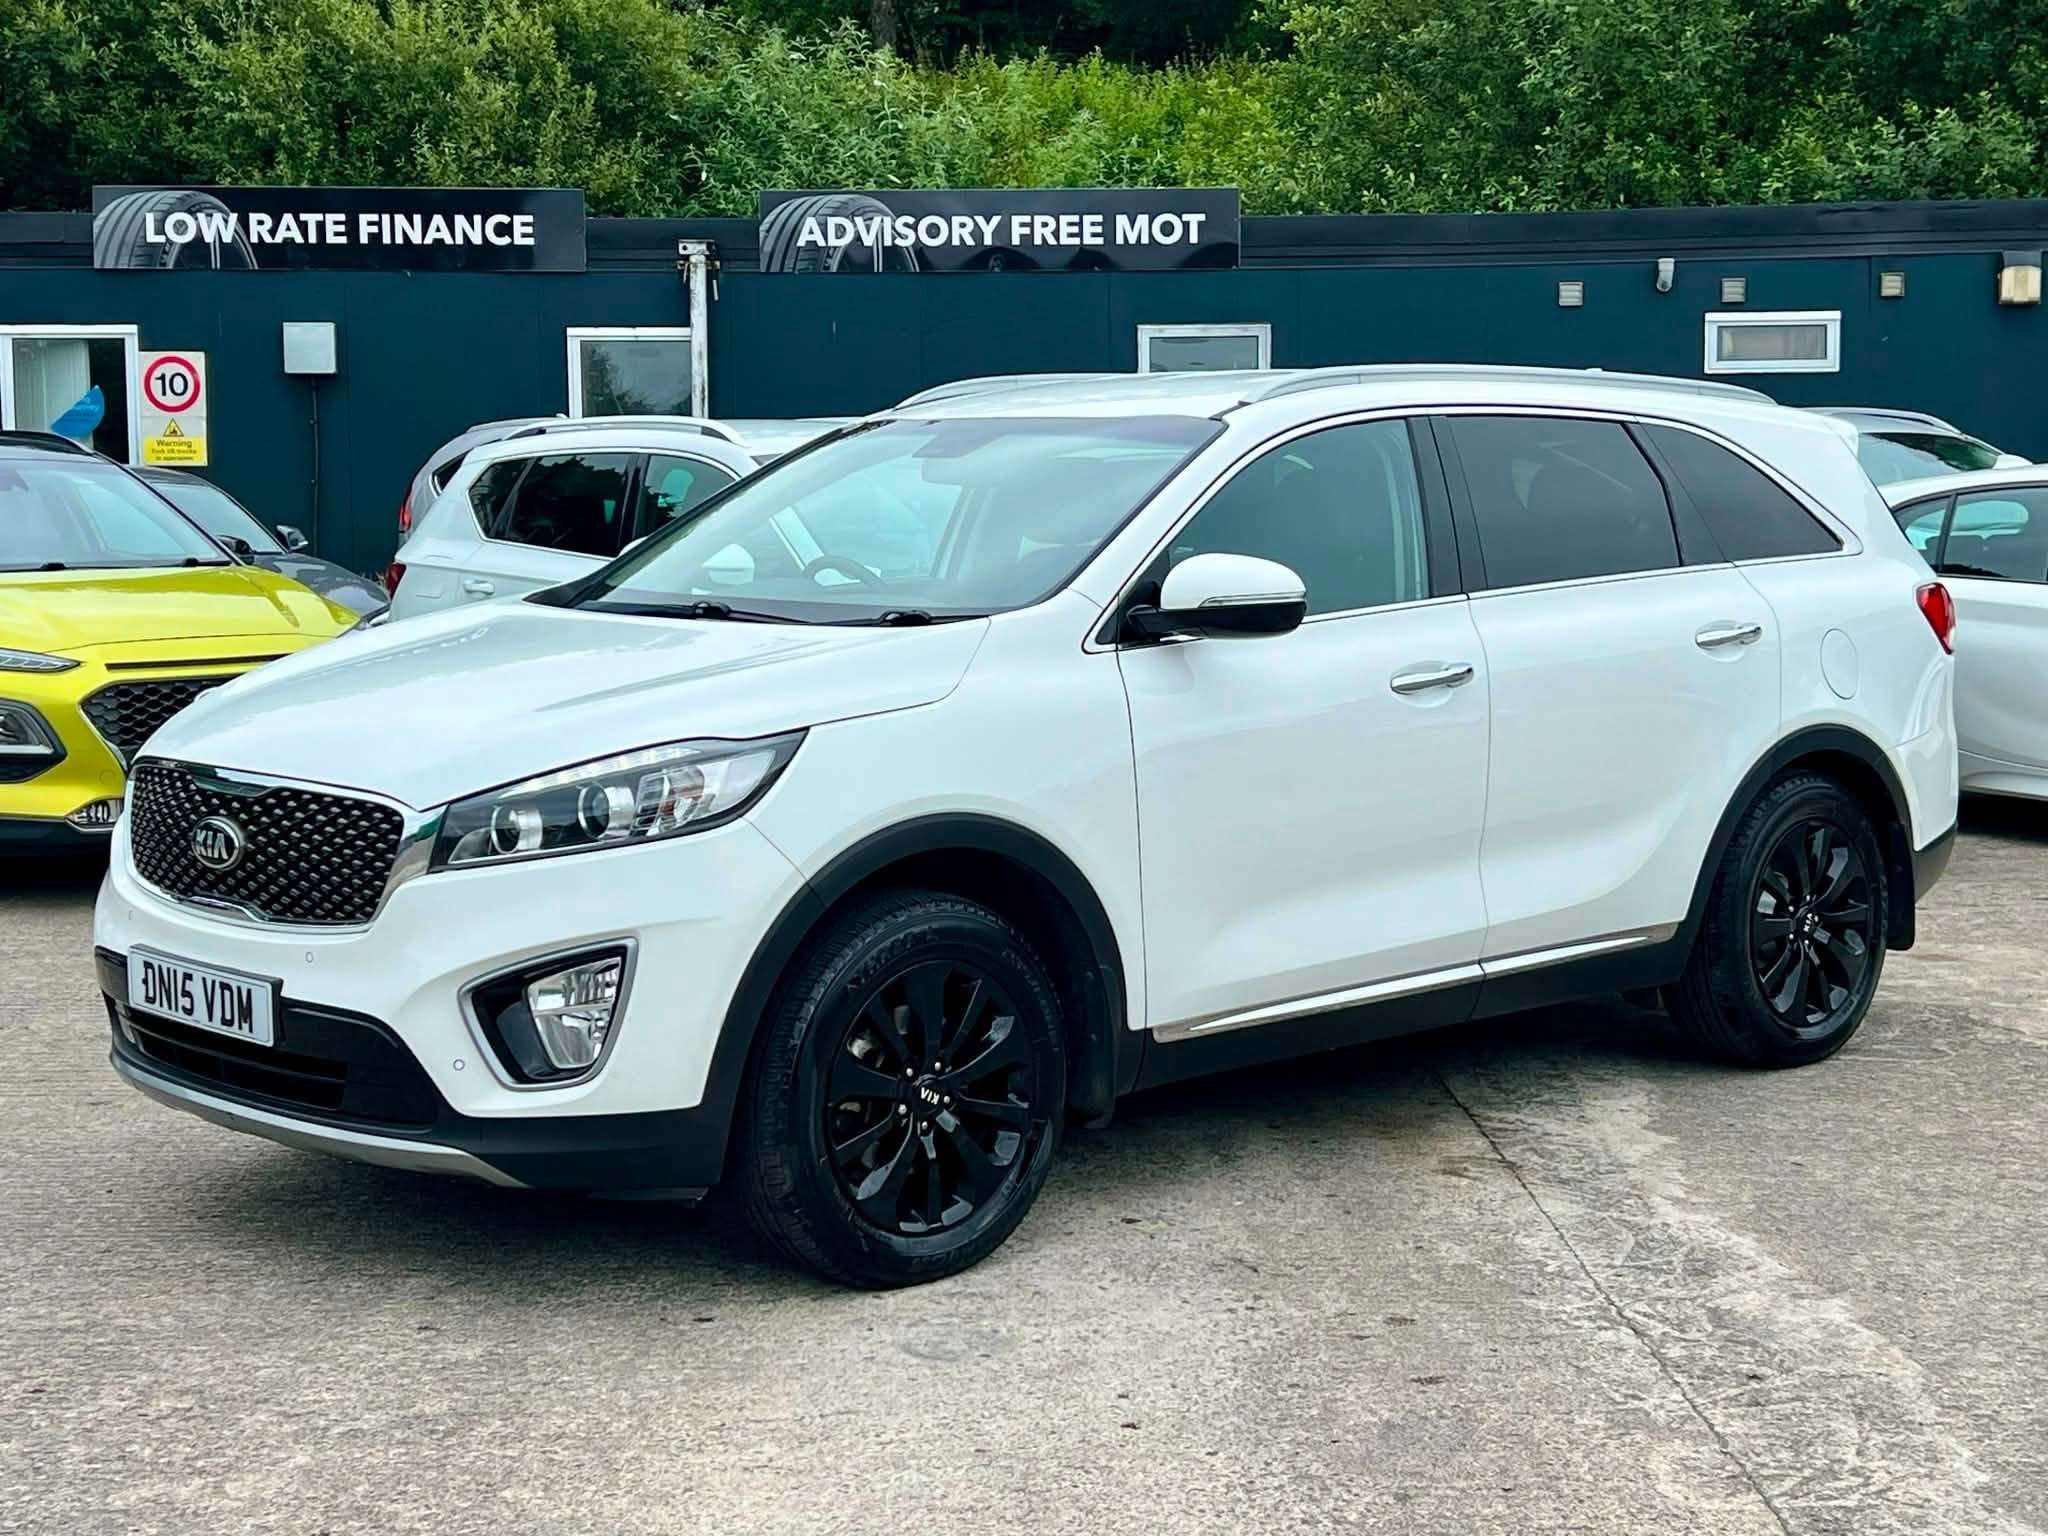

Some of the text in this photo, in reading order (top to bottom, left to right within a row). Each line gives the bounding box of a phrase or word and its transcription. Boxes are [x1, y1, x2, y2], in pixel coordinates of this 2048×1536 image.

[145, 212, 535, 246] LOW RATE FINANCE
[797, 213, 1206, 247] ADVISORY FREE MOT
[155, 372, 189, 397] 10
[155, 439, 193, 449] Warning
[195, 828, 229, 860] KIA
[141, 959, 254, 1034] DN15 VDM
[920, 1087, 940, 1105] KIA
